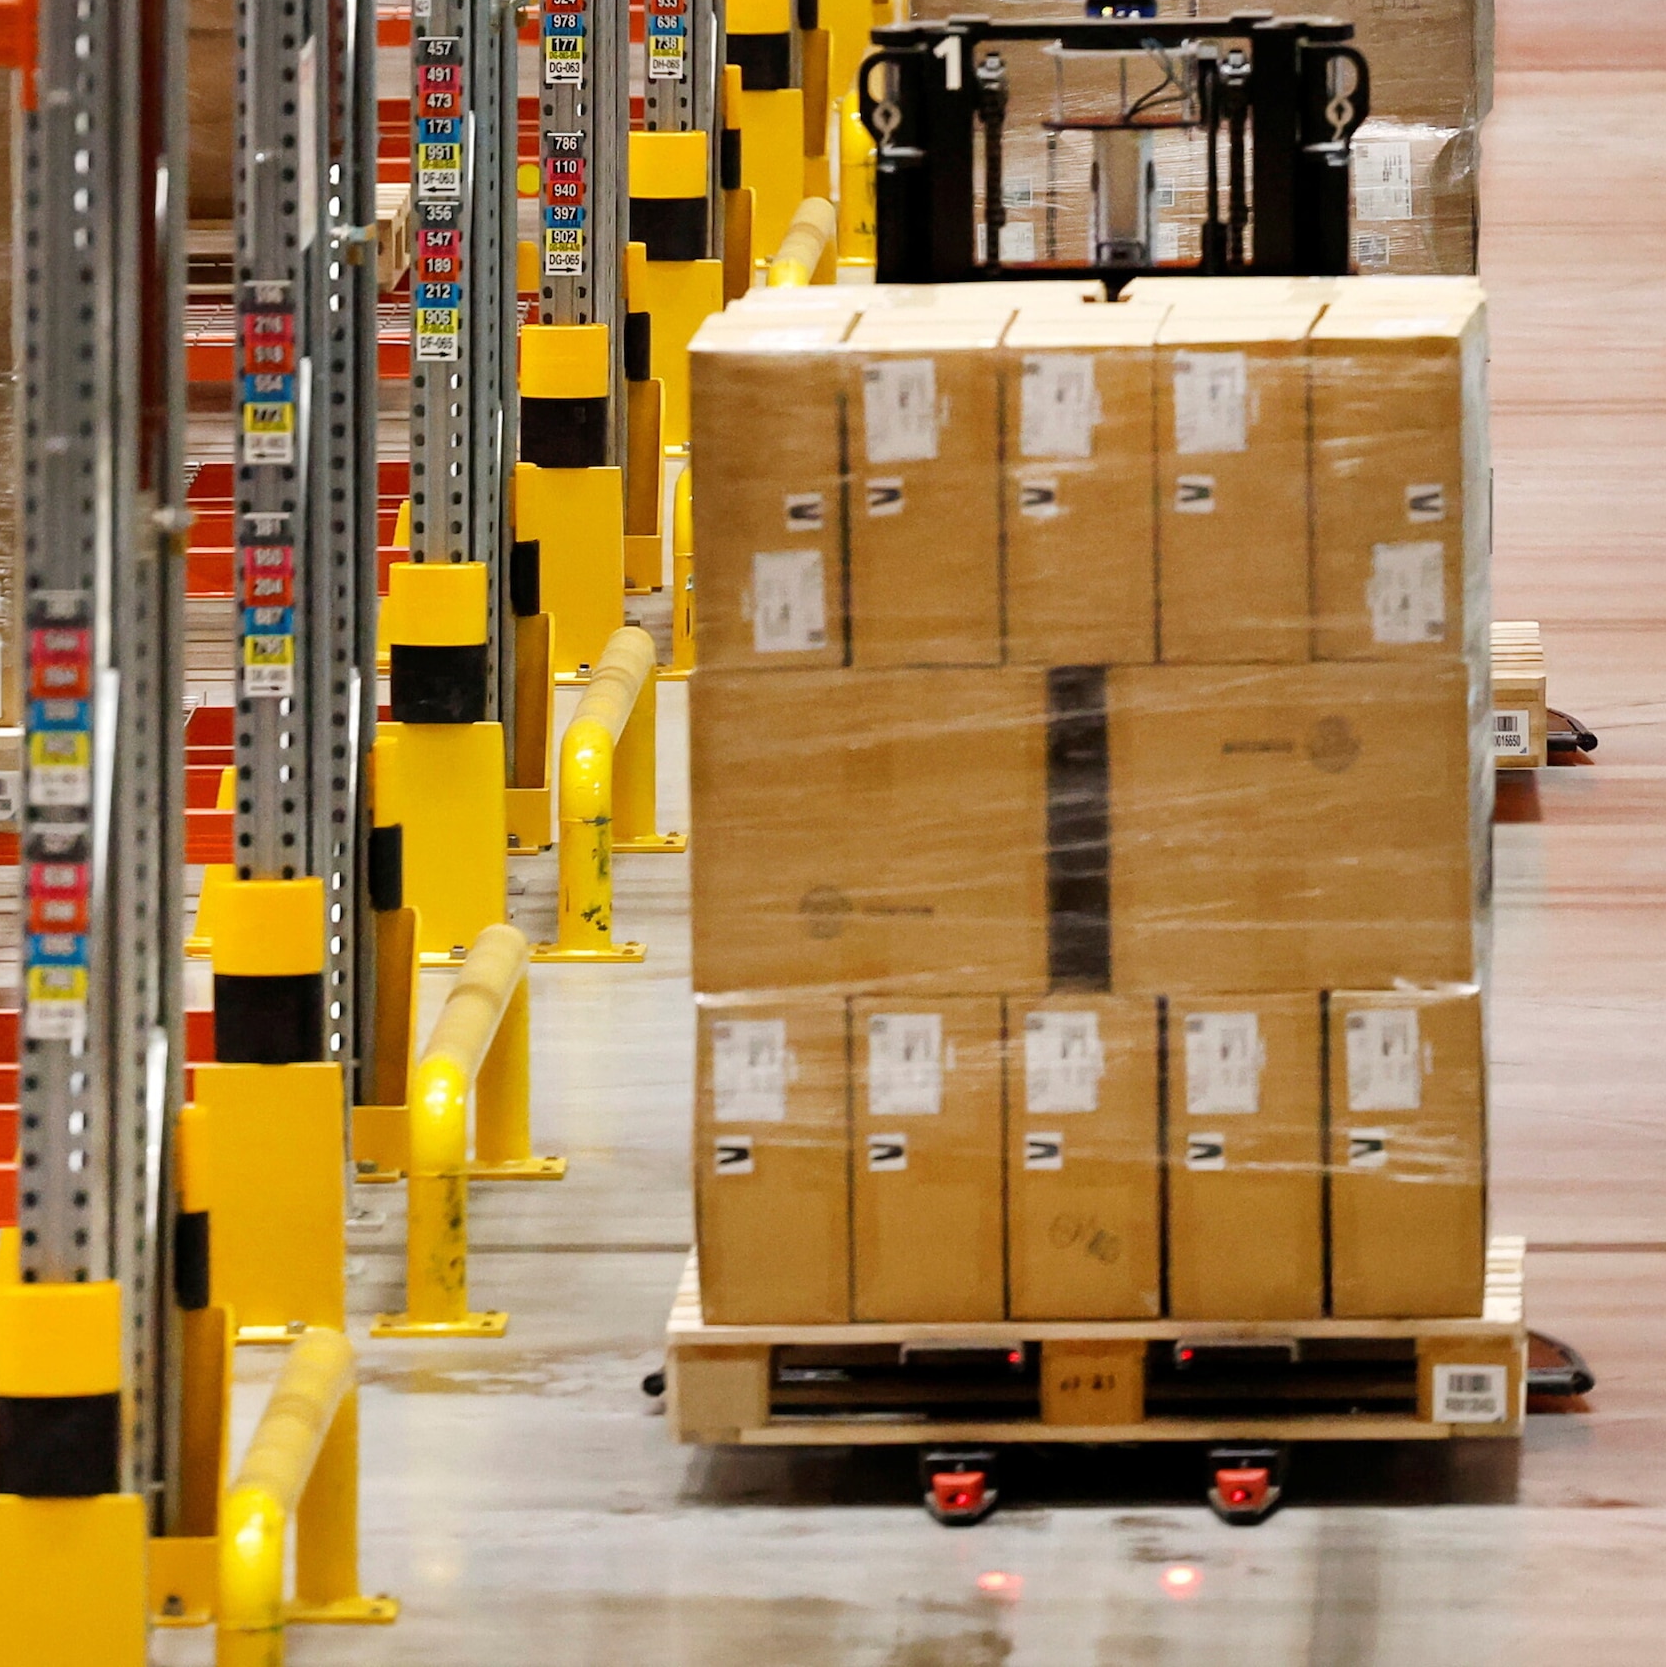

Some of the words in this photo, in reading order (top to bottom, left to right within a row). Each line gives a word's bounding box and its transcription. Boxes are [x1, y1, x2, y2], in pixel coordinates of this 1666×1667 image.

[553, 14, 576, 28] 978
[657, 15, 678, 29] 636
[427, 41, 452, 56] 457
[553, 38, 576, 51] 177
[549, 62, 580, 73] DG-063
[933, 35, 963, 91] 1
[427, 67, 452, 82] 491
[427, 93, 452, 108] 473
[427, 119, 452, 133] 173
[554, 136, 577, 151] 786
[427, 145, 452, 160] 991
[554, 160, 577, 174] 110
[422, 172, 455, 185] DF-063
[554, 183, 577, 197] 940
[426, 205, 452, 221] 356
[554, 206, 577, 220] 397
[426, 231, 452, 247] 547
[554, 230, 577, 243] 902
[426, 258, 452, 273] 189
[549, 254, 580, 265] DG-065
[426, 284, 452, 299] 212
[426, 309, 452, 325] 906
